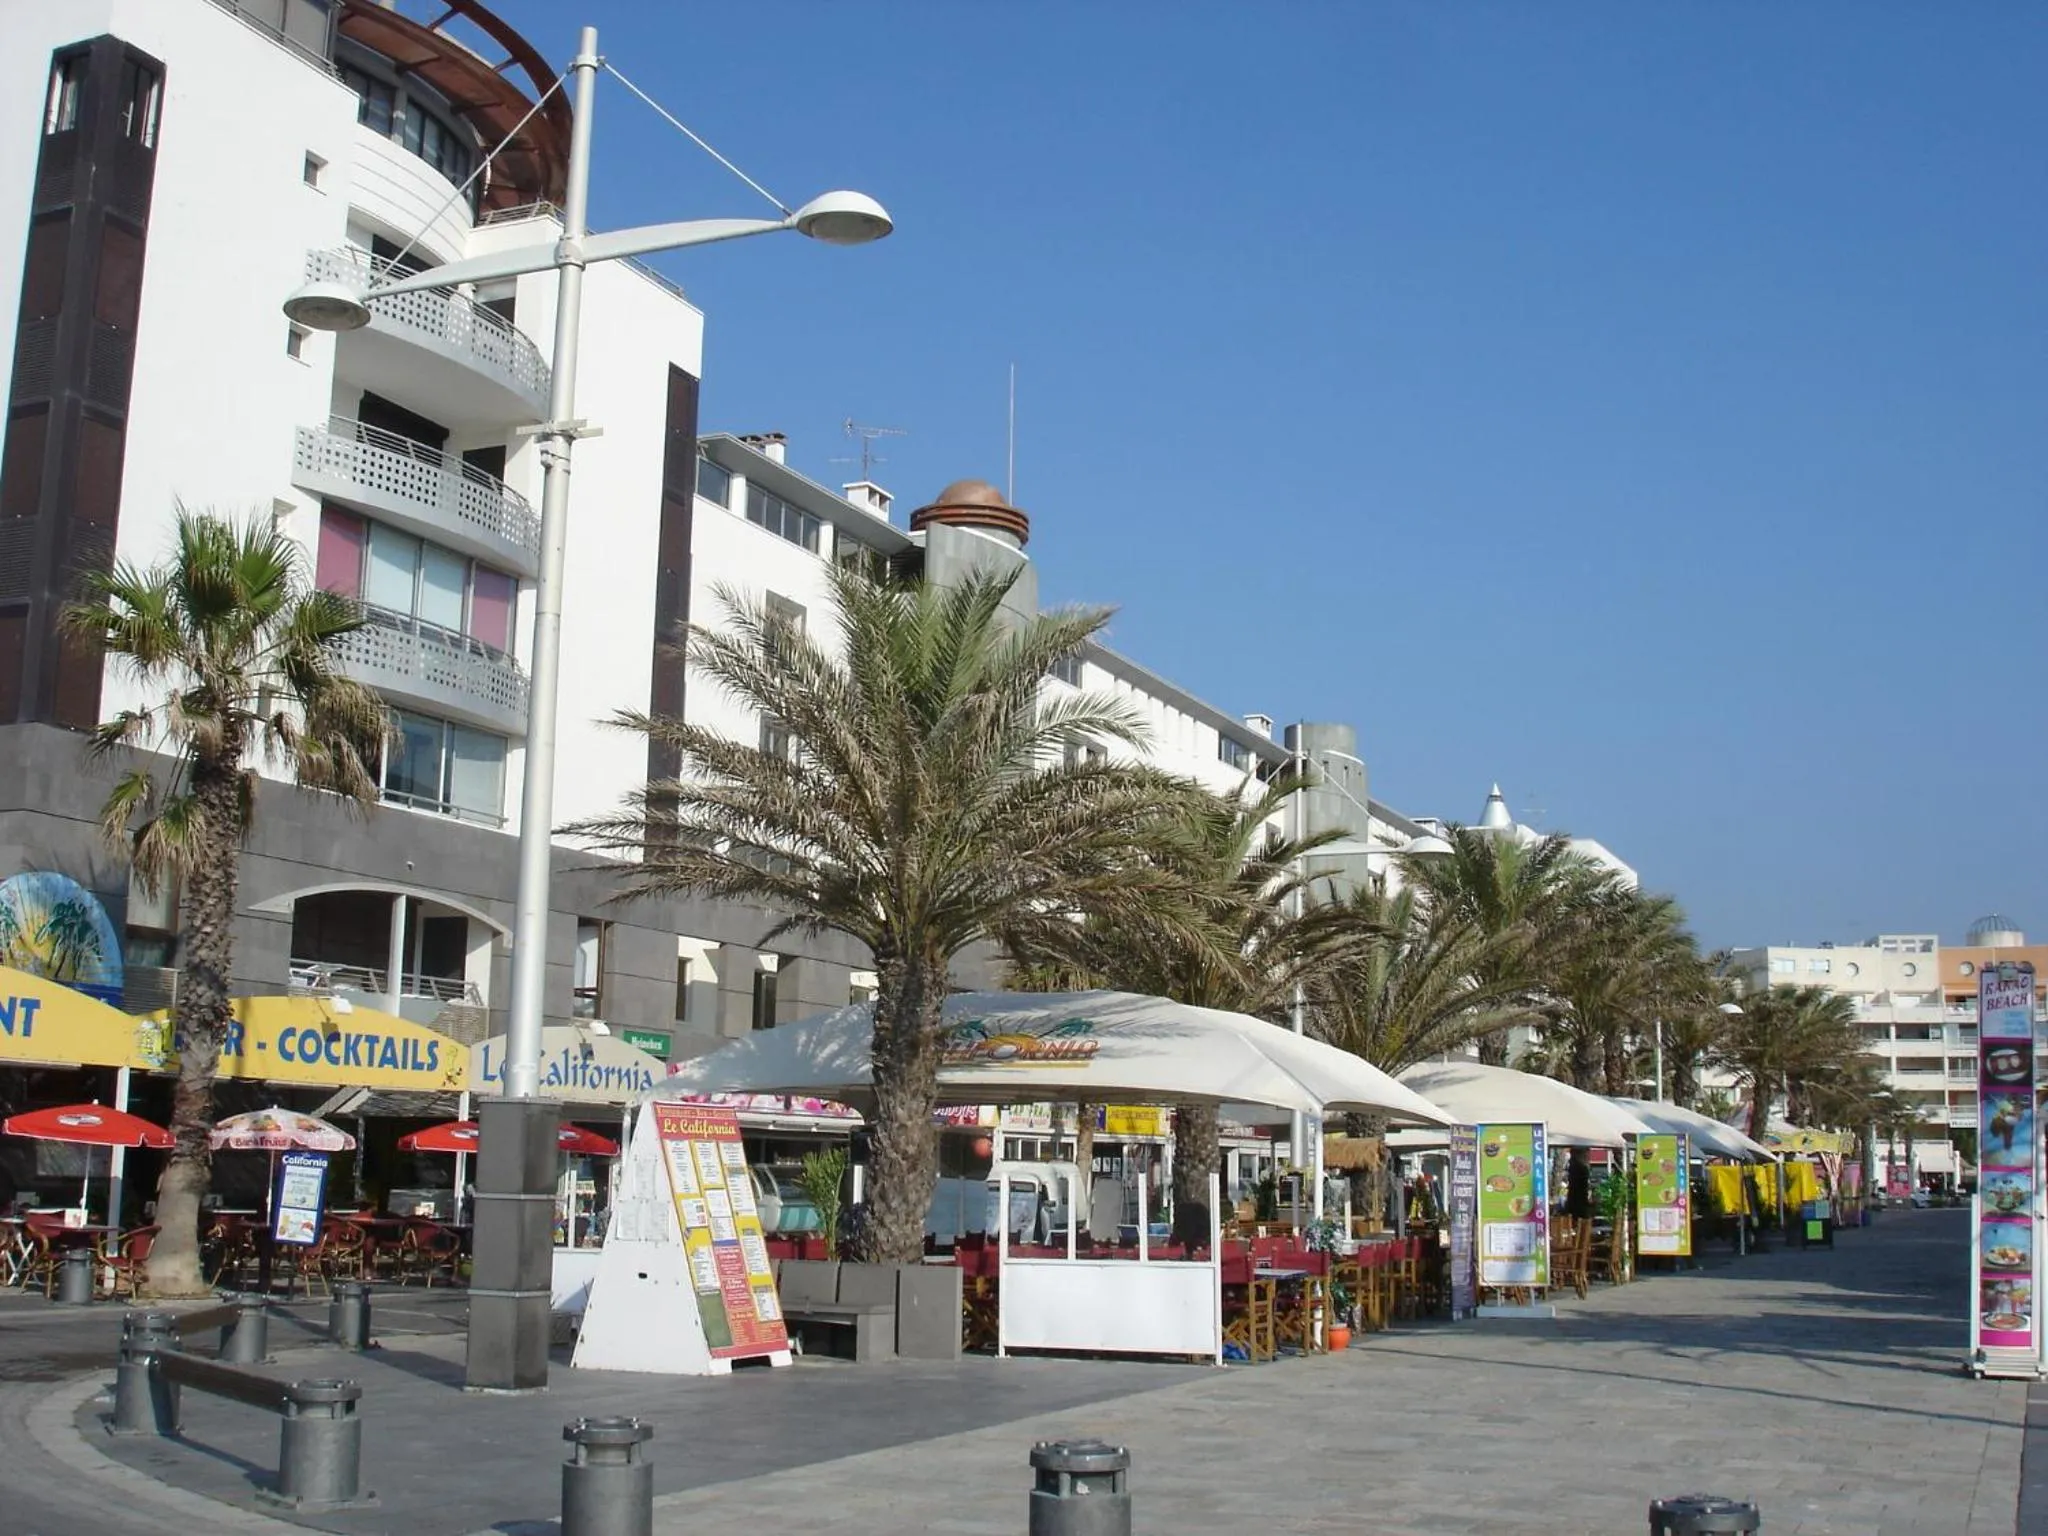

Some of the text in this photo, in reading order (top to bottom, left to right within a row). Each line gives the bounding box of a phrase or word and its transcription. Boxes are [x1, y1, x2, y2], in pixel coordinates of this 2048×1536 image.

[0, 996, 41, 1037] NT
[1986, 993, 2028, 1011] BEACH
[278, 1026, 439, 1072] COCKTAILS
[539, 1046, 653, 1091] alifornia
[664, 1118, 737, 1139] Le California
[283, 1155, 328, 1168] California
[1534, 1142, 1545, 1273] CALIFORNIA
